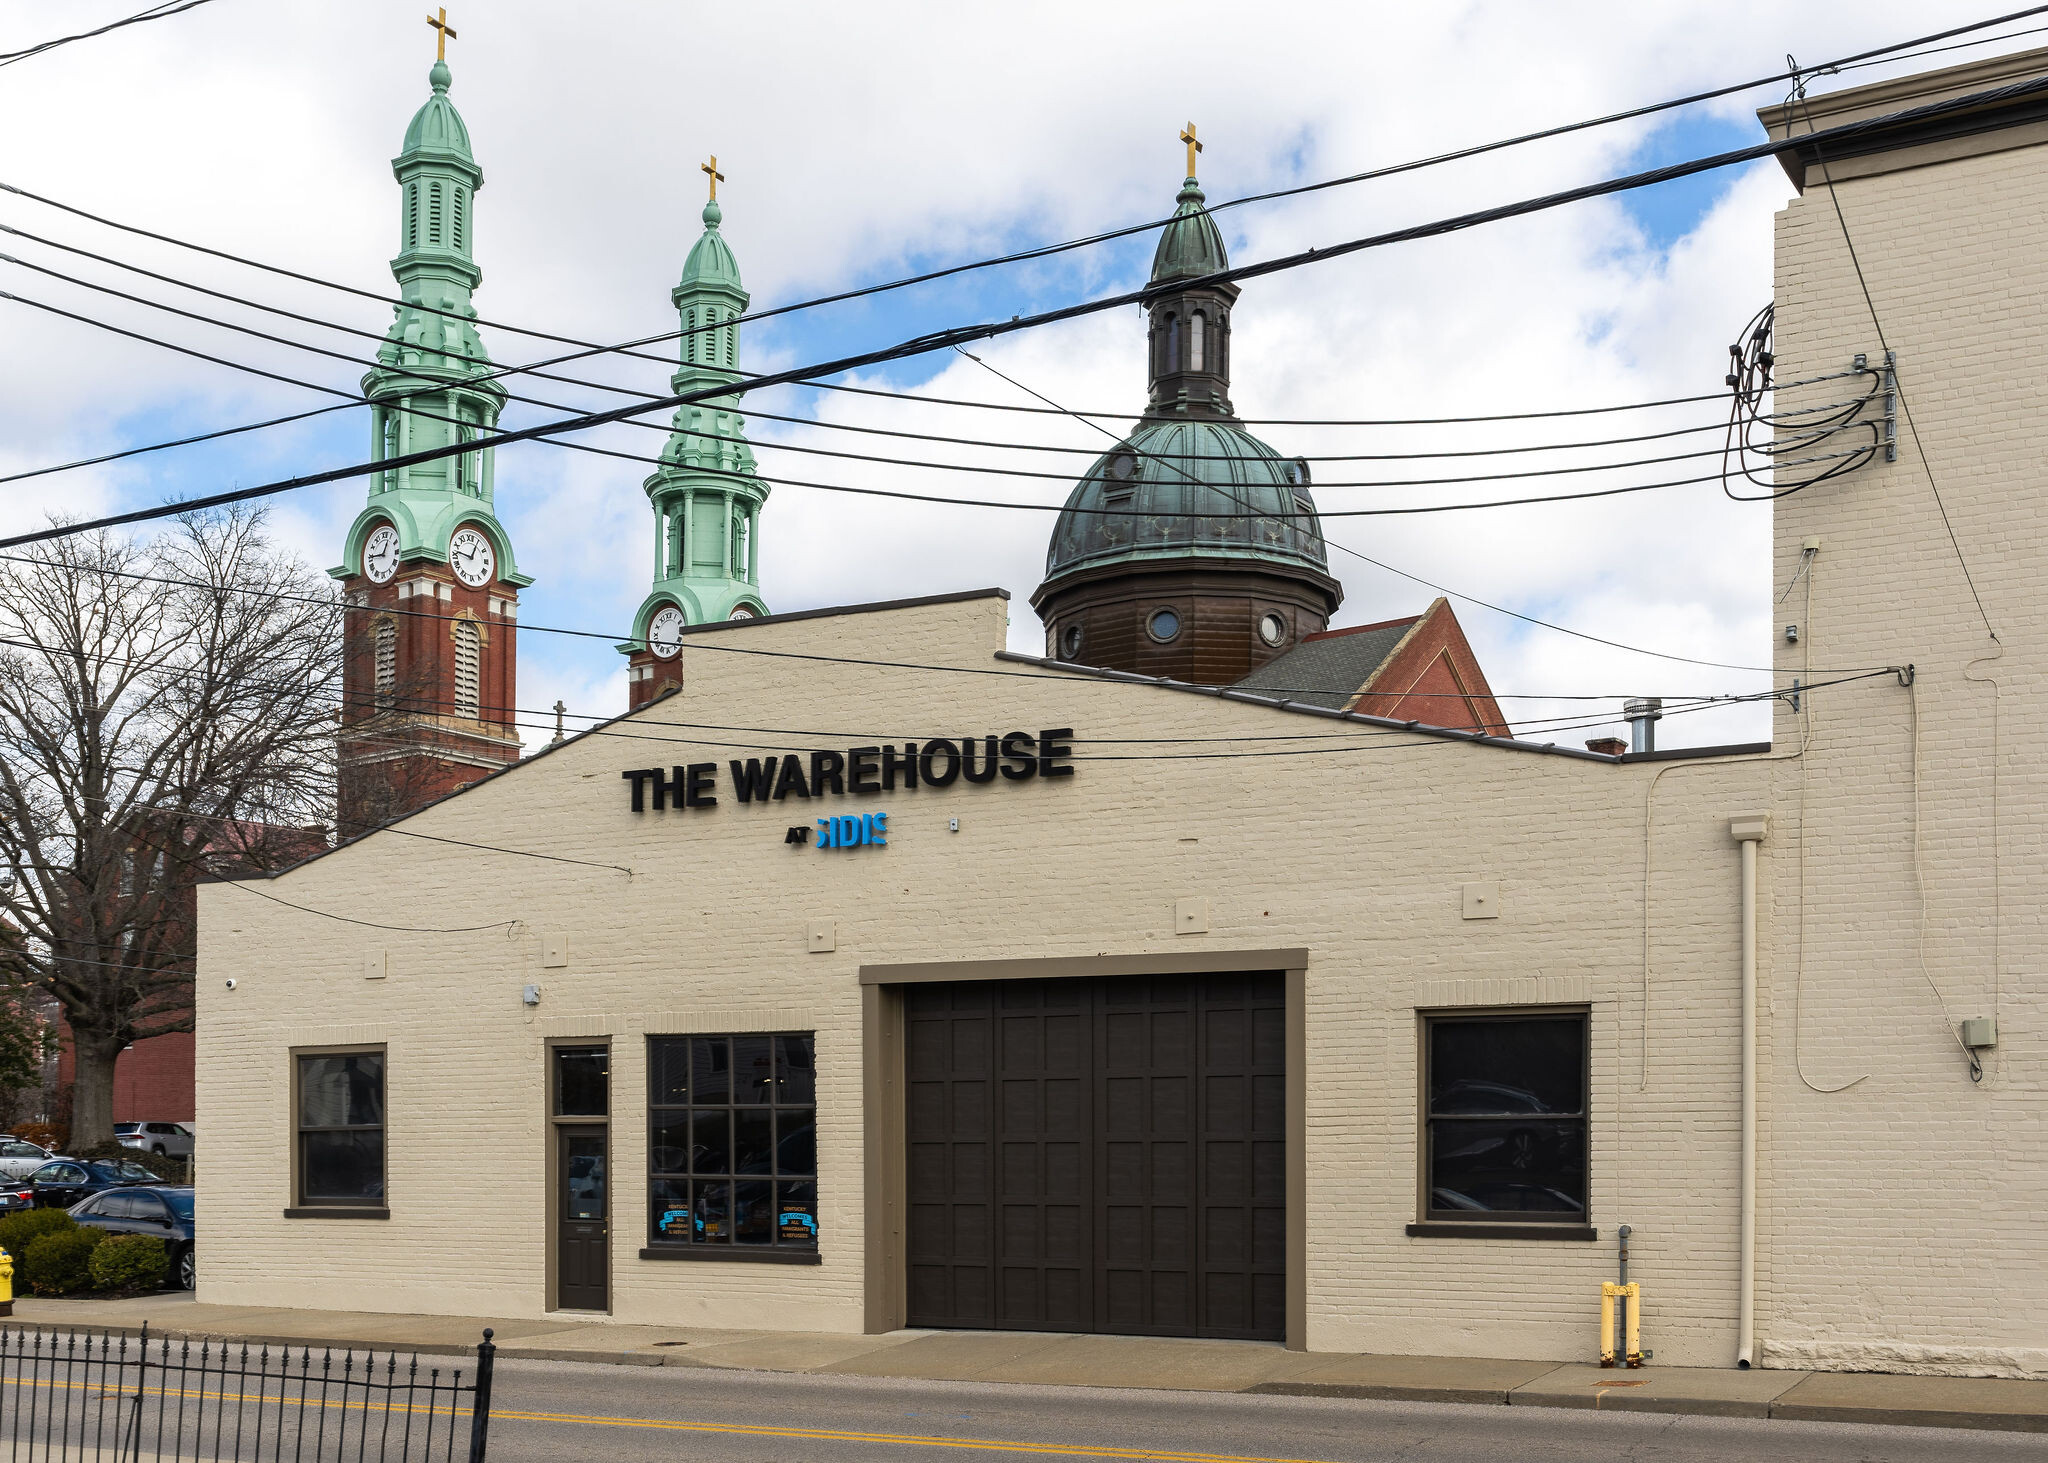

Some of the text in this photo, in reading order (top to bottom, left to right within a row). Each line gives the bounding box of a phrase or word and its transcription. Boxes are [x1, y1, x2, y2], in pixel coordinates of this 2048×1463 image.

[622, 728, 1074, 813] THE WAREHOUSE
[784, 826, 812, 844] AT
